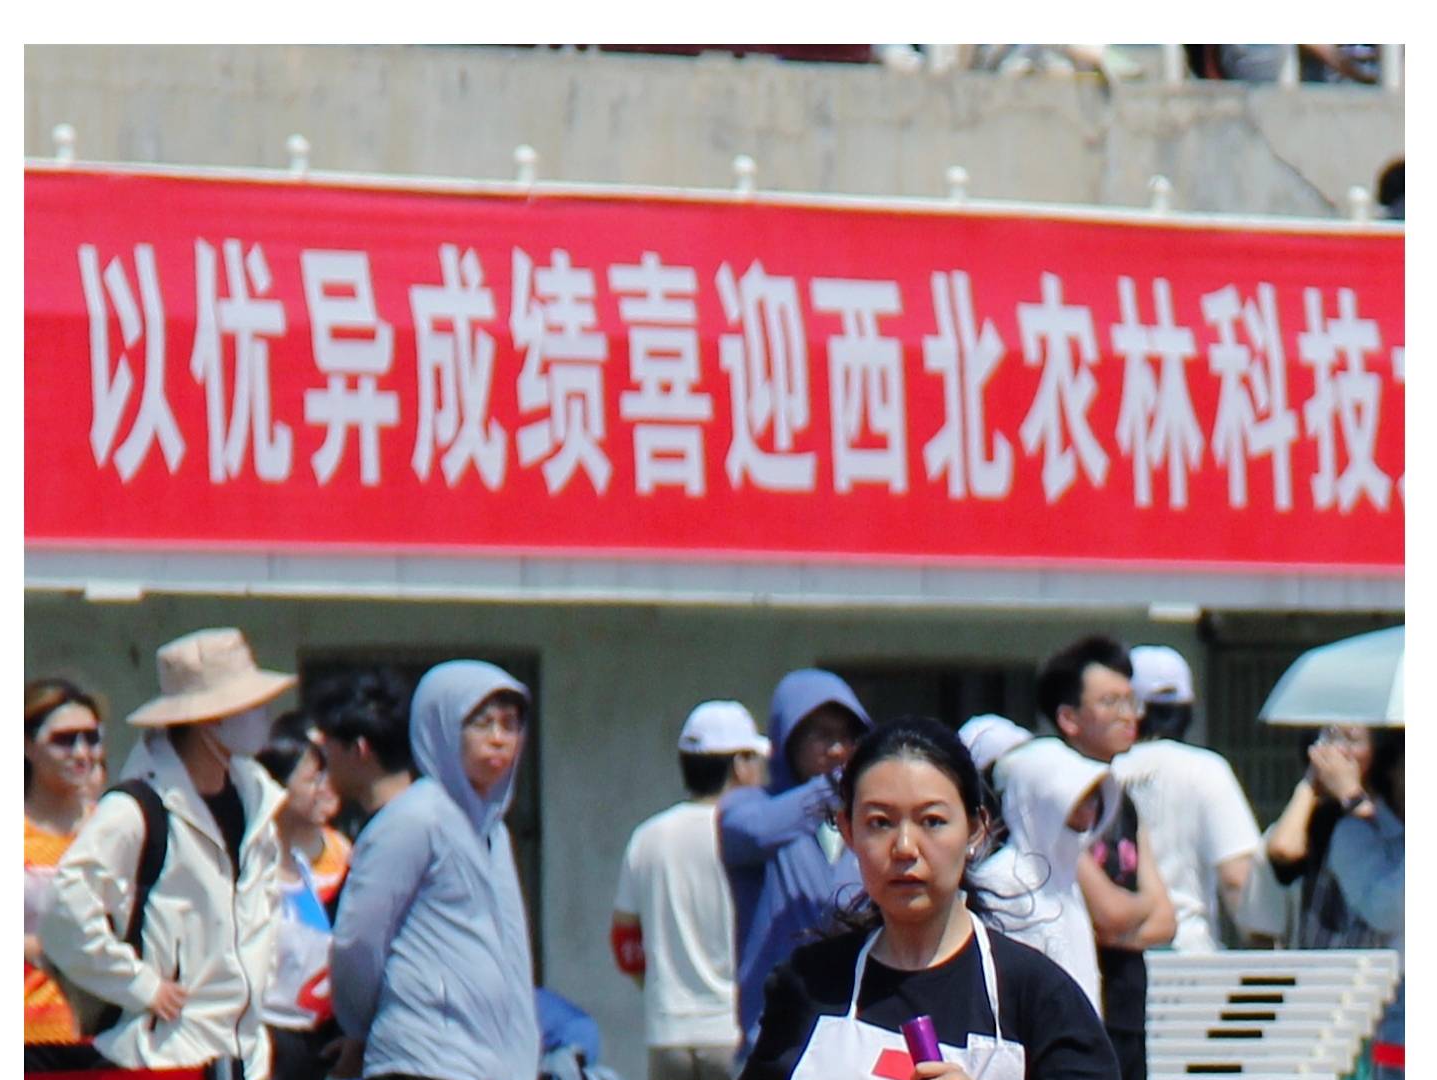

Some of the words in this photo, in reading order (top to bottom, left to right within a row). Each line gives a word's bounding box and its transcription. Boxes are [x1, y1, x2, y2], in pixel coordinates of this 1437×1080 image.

[78, 236, 1405, 514] 以优异成绩喜迎西北农林科技
